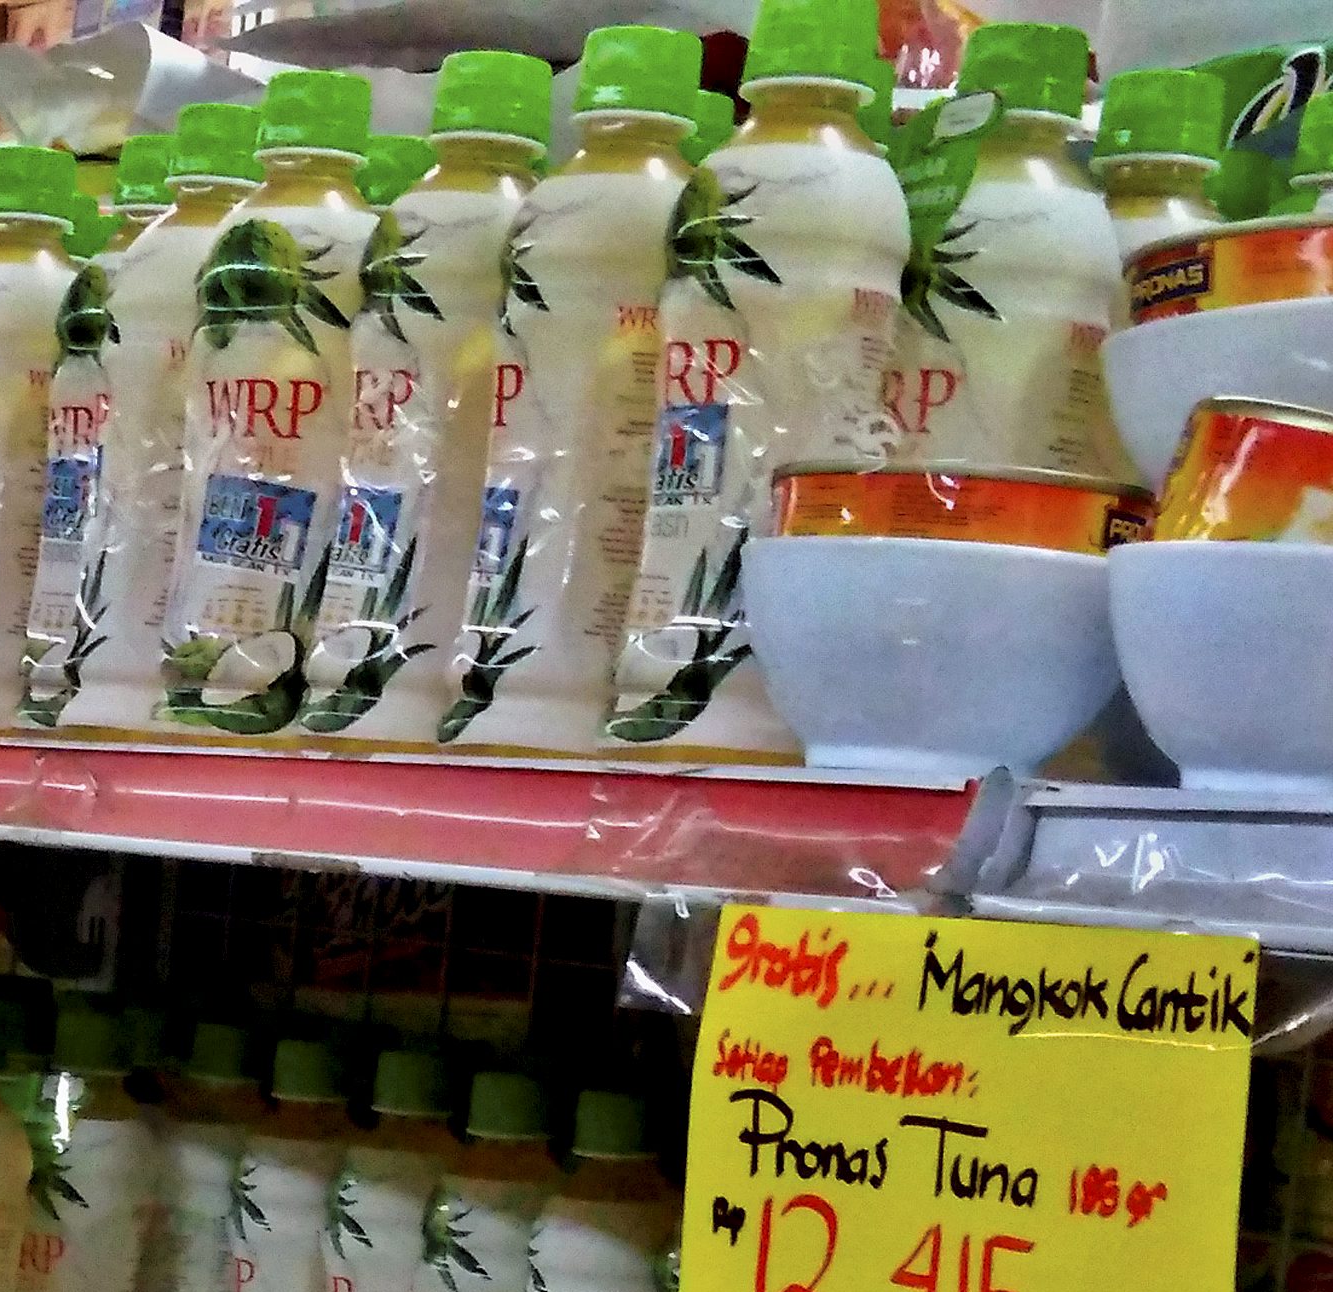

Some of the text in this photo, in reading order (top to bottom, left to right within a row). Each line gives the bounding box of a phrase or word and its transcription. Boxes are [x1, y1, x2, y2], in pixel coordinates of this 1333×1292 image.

[618, 306, 659, 329] WR
[354, 369, 413, 430] RP
[665, 339, 741, 408] RP
[882, 367, 958, 433] RP
[206, 379, 323, 439] WRP
[918, 931, 1110, 1036] Mangkok
[1116, 951, 1257, 1038] Cantik
[729, 1088, 891, 1190] Pronas
[900, 1113, 1040, 1209] Tuna
[712, 1195, 747, 1247] Rp
